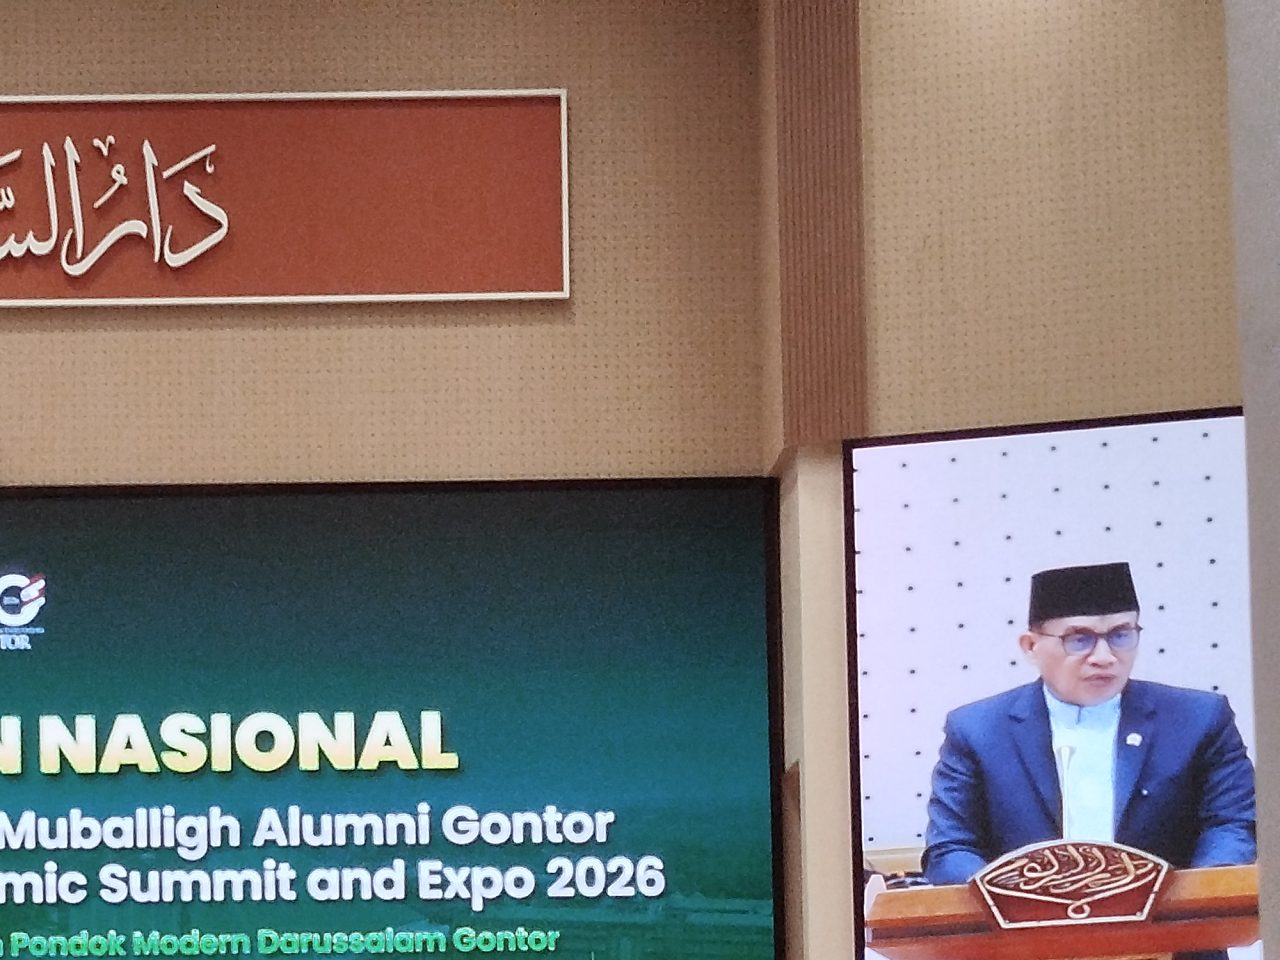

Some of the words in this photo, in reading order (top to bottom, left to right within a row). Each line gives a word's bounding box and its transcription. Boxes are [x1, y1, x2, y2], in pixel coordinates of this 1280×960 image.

[39, 710, 459, 774] NASIONAL
[252, 801, 431, 847] Alumni
[441, 804, 615, 845] Gontor
[98, 854, 297, 904] Summit
[306, 858, 406, 901] and
[417, 859, 536, 912] Expo
[546, 855, 666, 898] 2026
[9, 929, 127, 958] Pondok
[131, 928, 251, 956] Modern
[256, 926, 447, 955] Darussalam
[452, 926, 561, 953] Gontor
